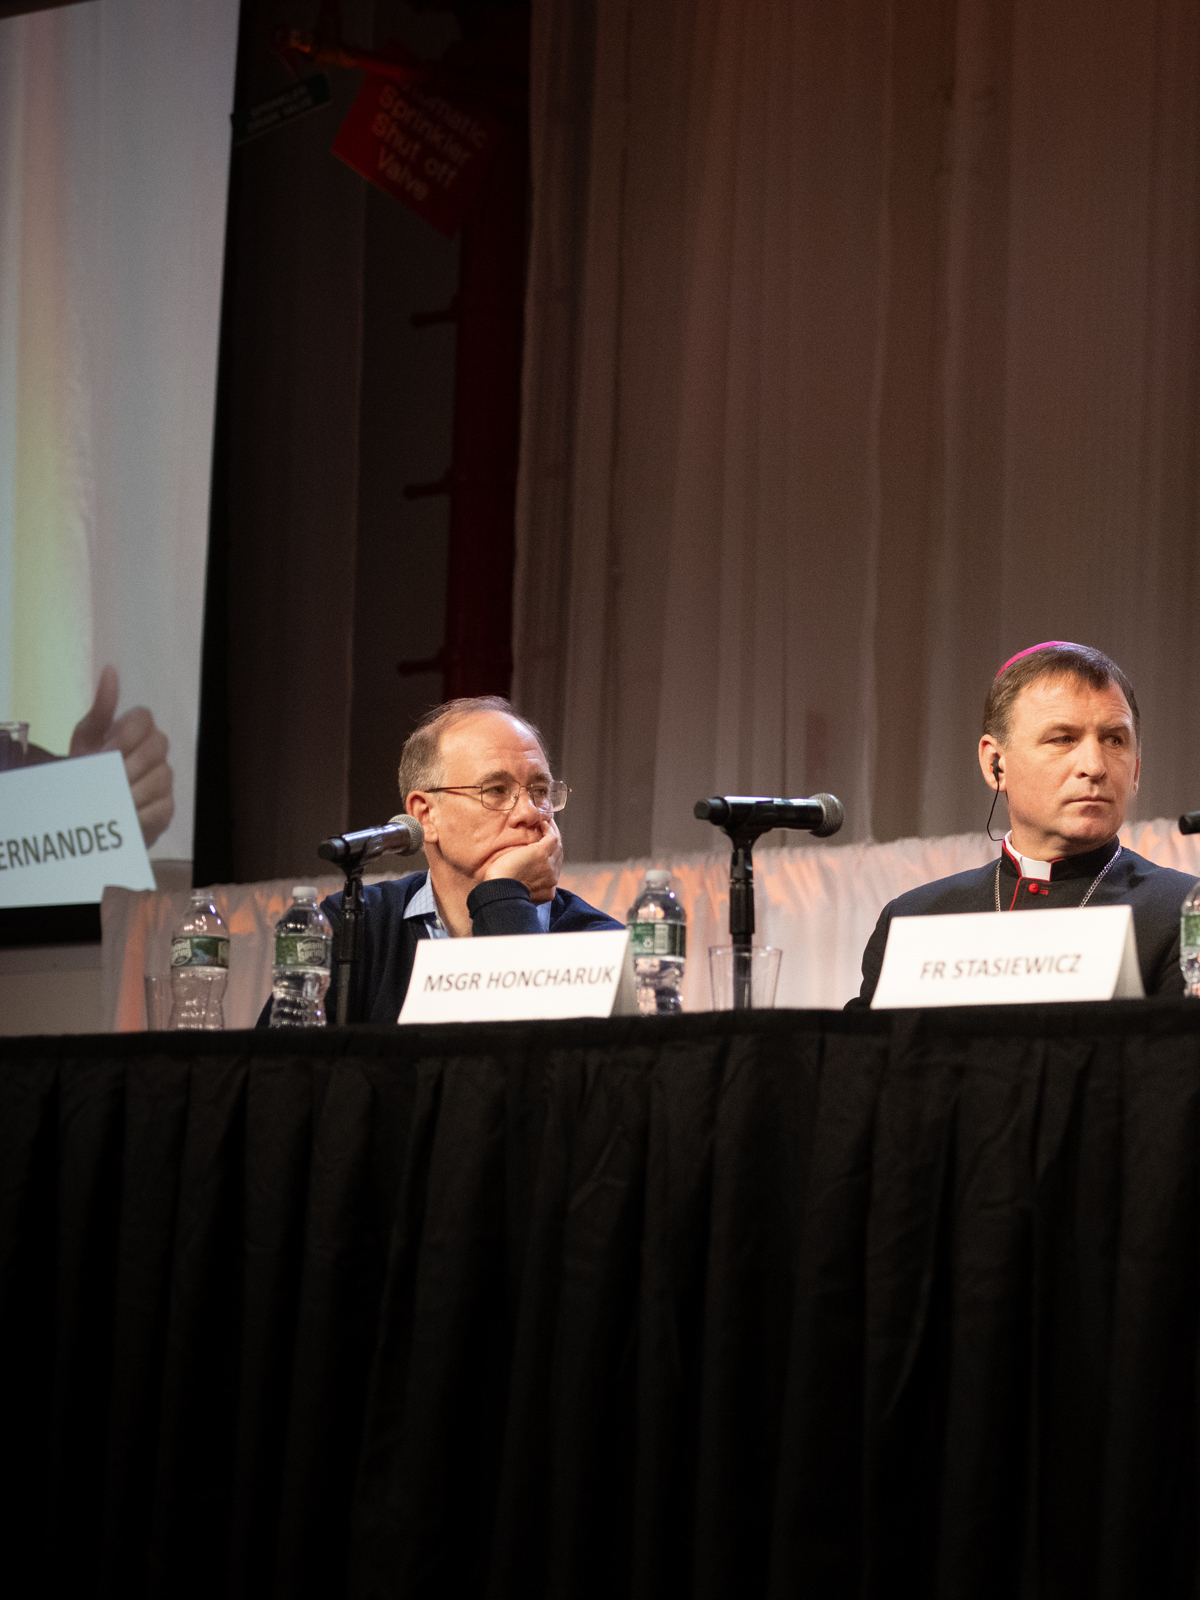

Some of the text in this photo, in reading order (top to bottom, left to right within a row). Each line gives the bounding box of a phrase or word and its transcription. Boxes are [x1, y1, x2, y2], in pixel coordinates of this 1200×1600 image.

[371, 112, 422, 161] Shut
[378, 84, 472, 167] Sprinkler
[377, 146, 429, 202] Valve
[423, 965, 617, 993] MSGR HONCHARUK
[920, 953, 1083, 981] FR STASIEWICZ
